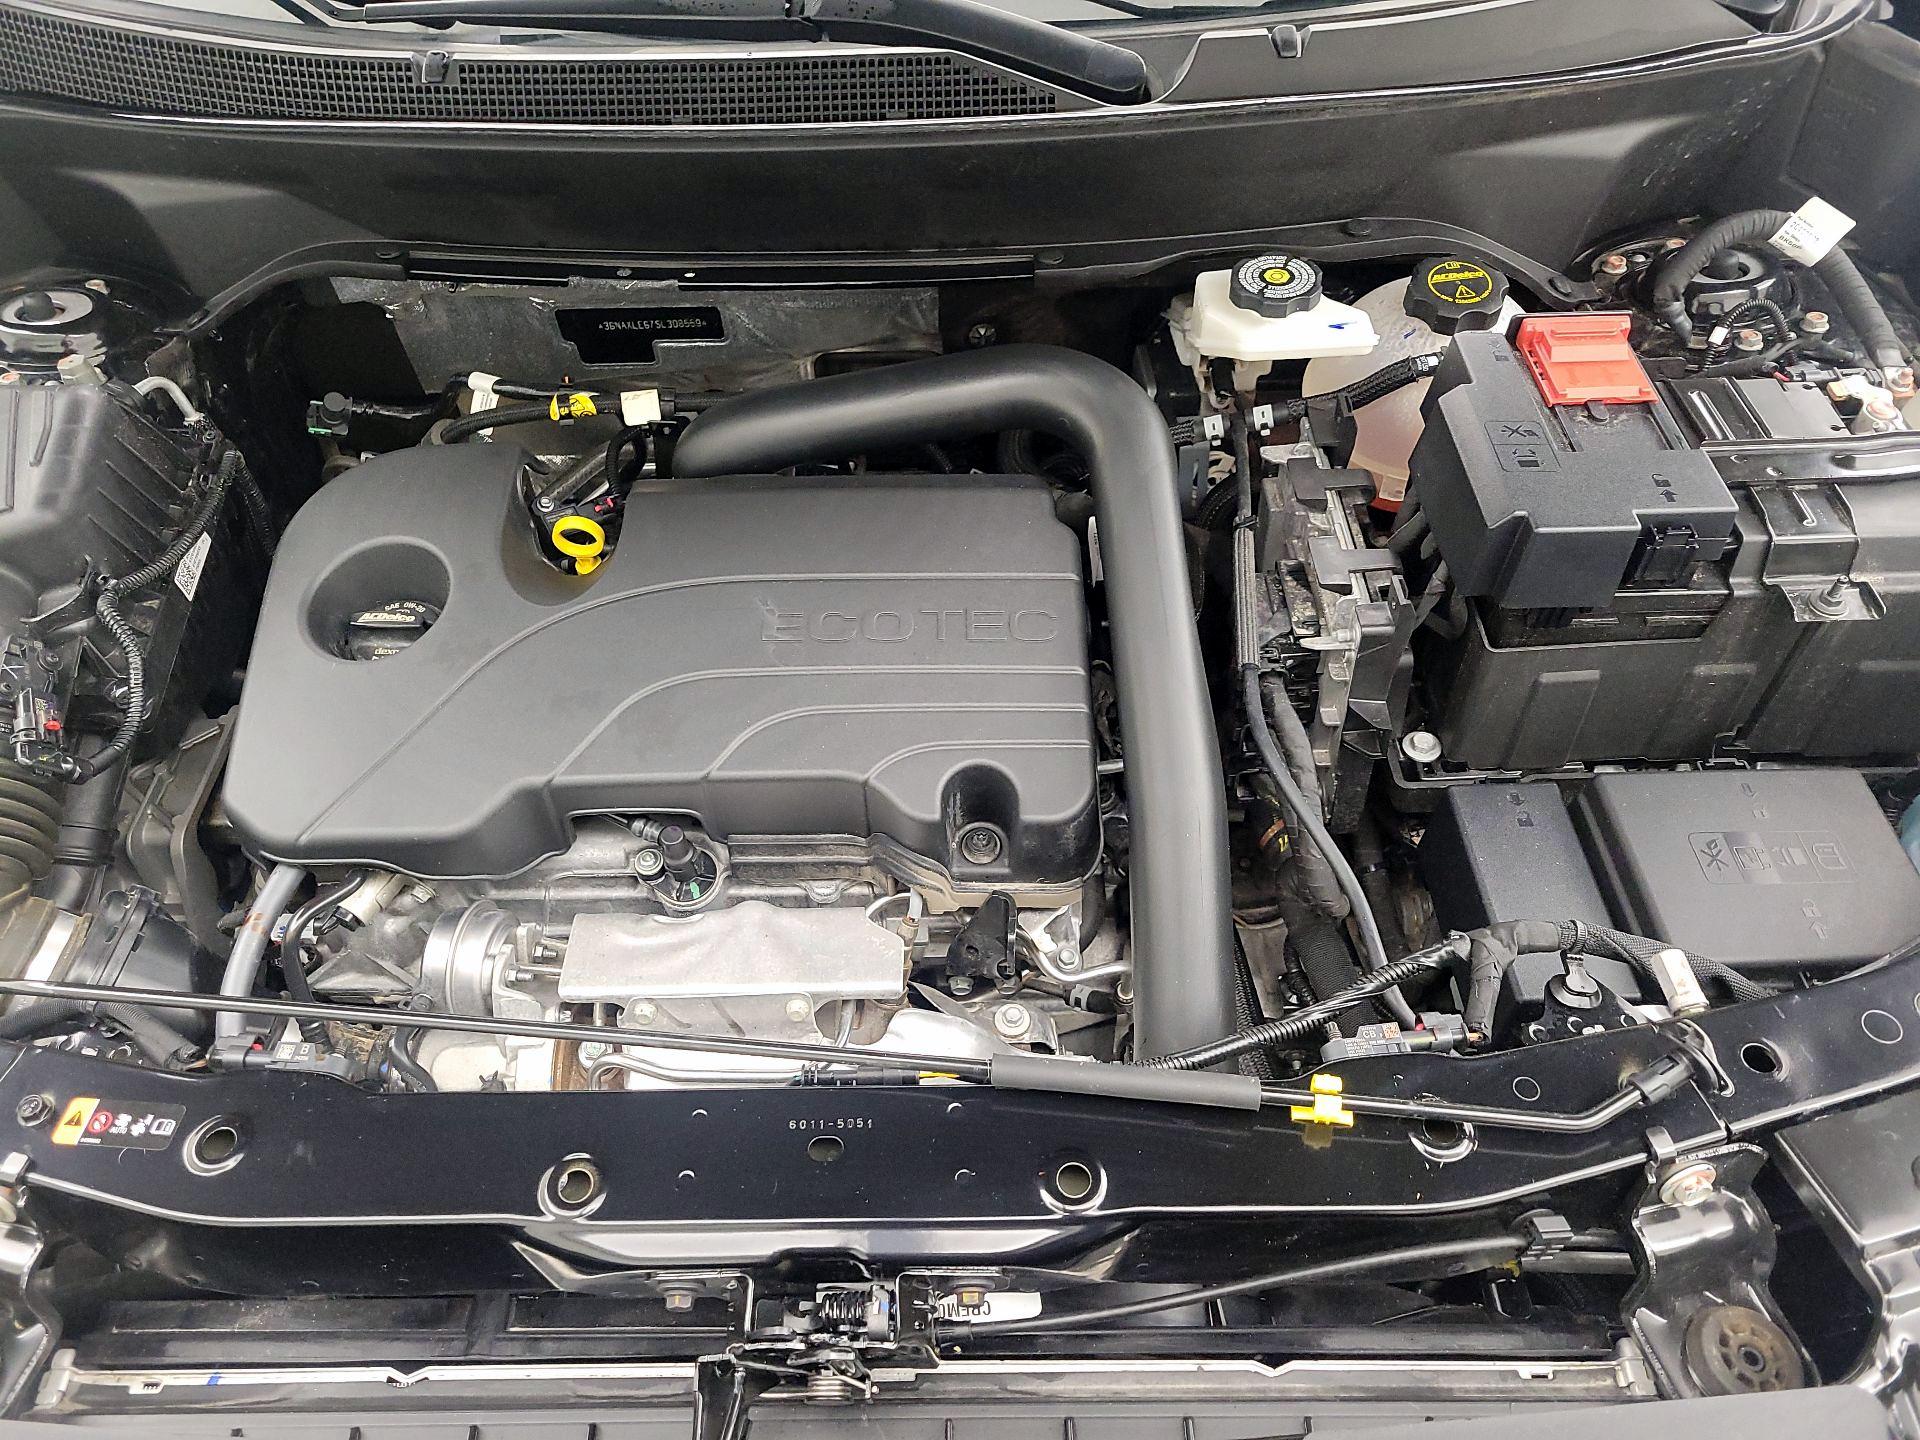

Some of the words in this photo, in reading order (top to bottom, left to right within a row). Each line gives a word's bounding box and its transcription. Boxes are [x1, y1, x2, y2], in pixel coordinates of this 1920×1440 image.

[357, 612, 416, 623] ACDelco
[761, 609, 1058, 643] ECOTEC
[788, 1117, 873, 1130] 6011-5051
